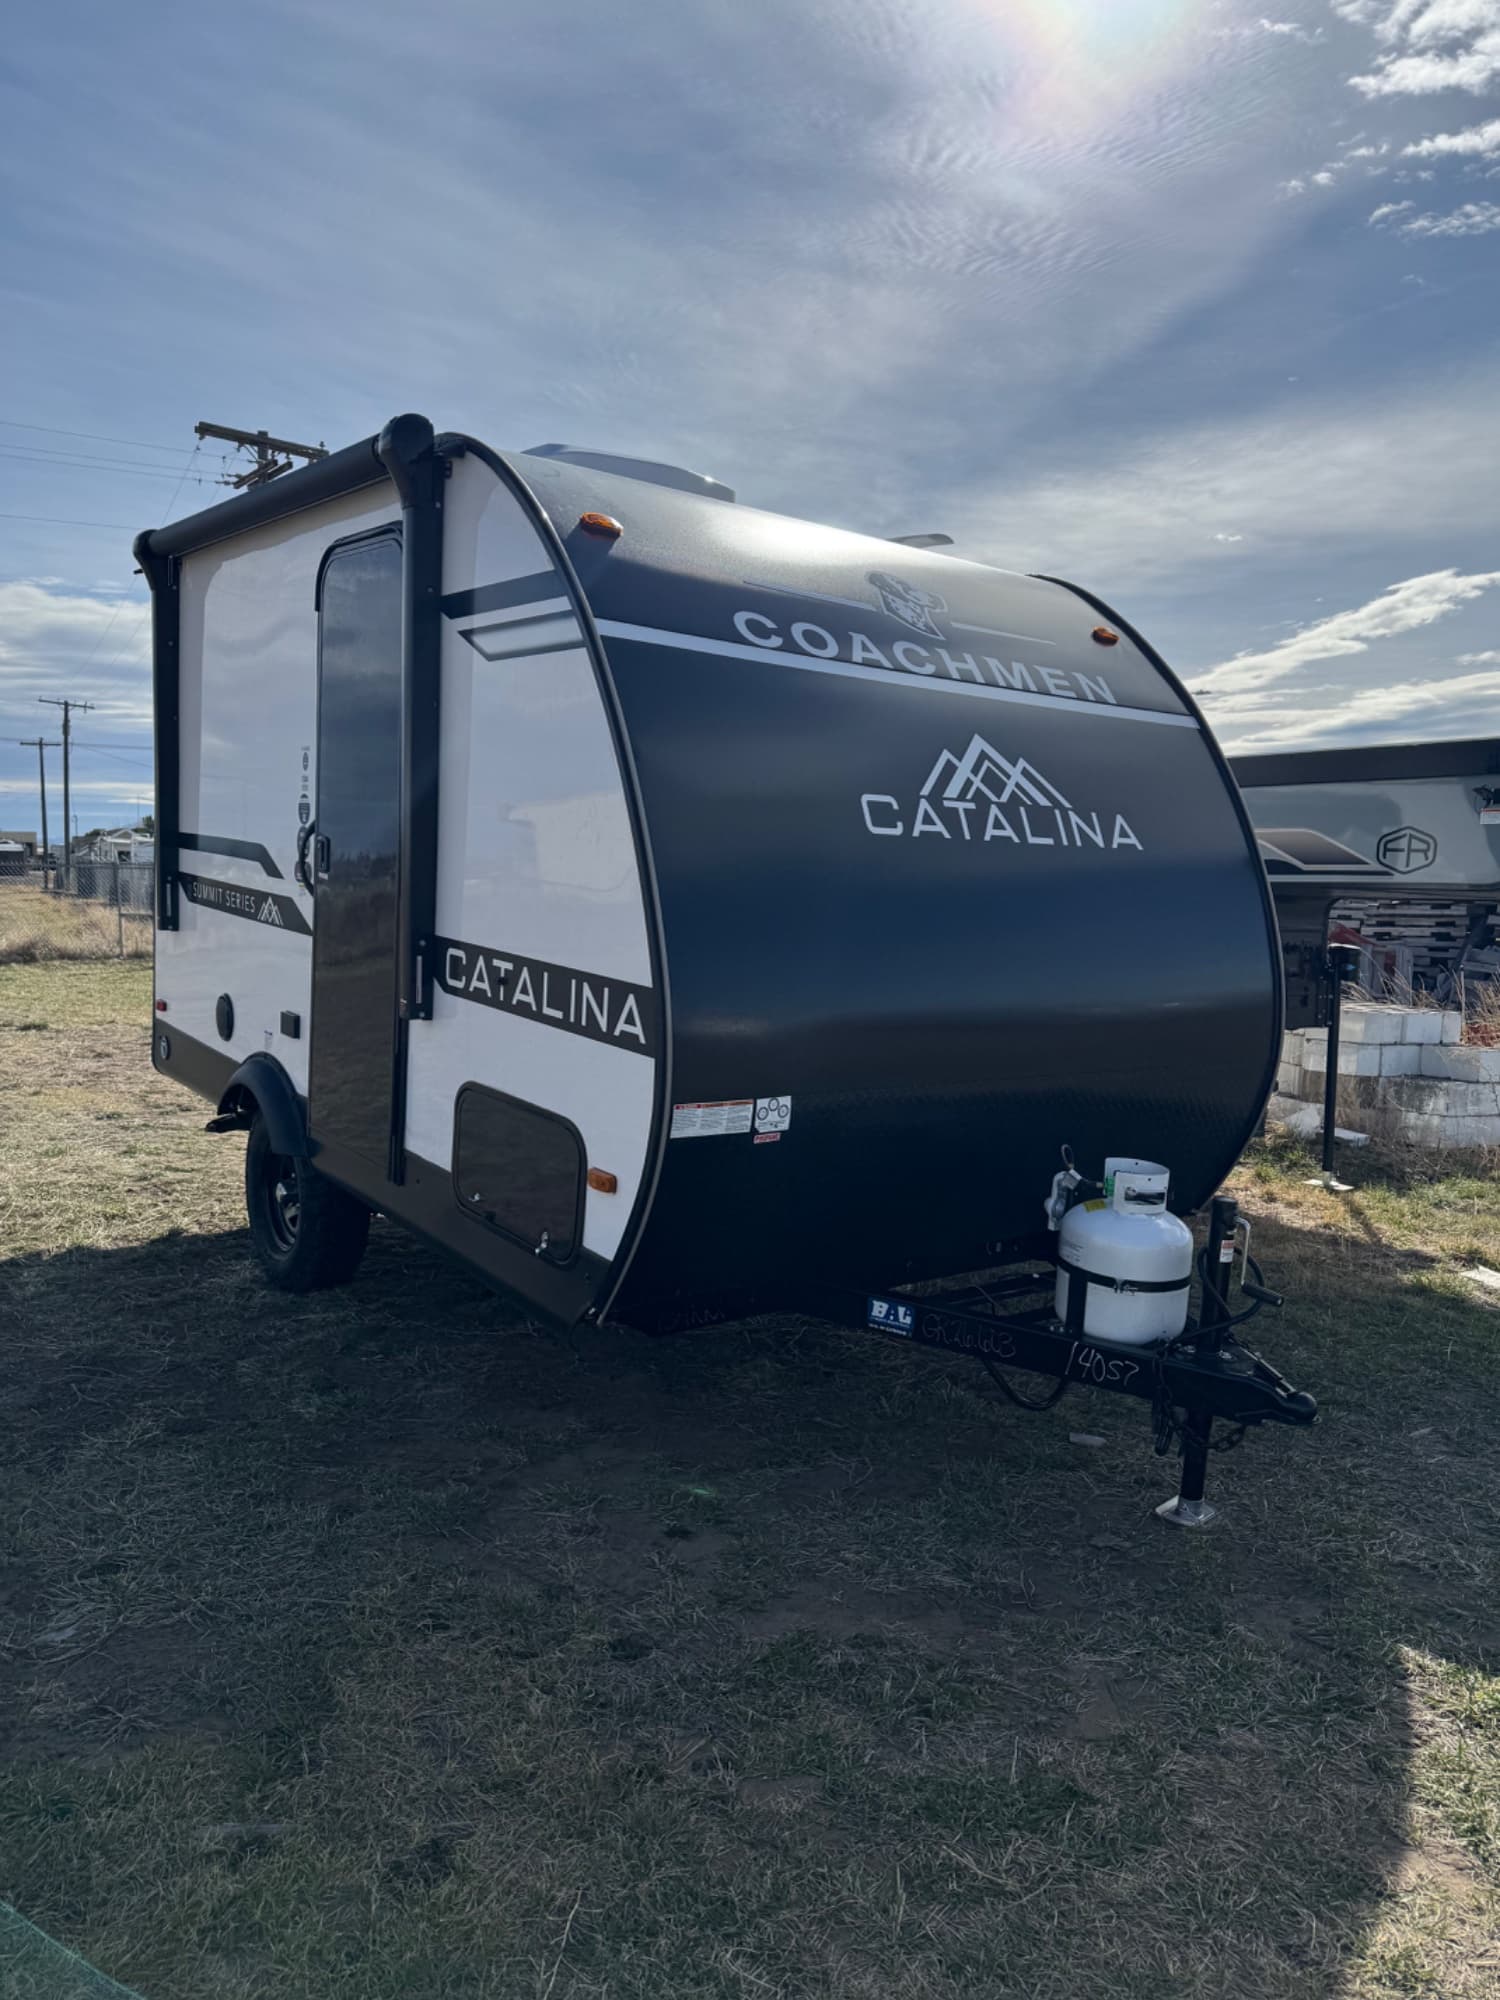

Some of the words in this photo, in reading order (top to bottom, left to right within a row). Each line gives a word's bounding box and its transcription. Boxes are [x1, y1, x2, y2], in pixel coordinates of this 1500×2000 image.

[733, 610, 1118, 705] COACHMEN
[860, 793, 1144, 851] CATALINA
[192, 881, 224, 904] SUMMIT
[225, 890, 256, 913] SERIES
[445, 946, 648, 1045] CATALINA
[1064, 1341, 1140, 1387] 14057
